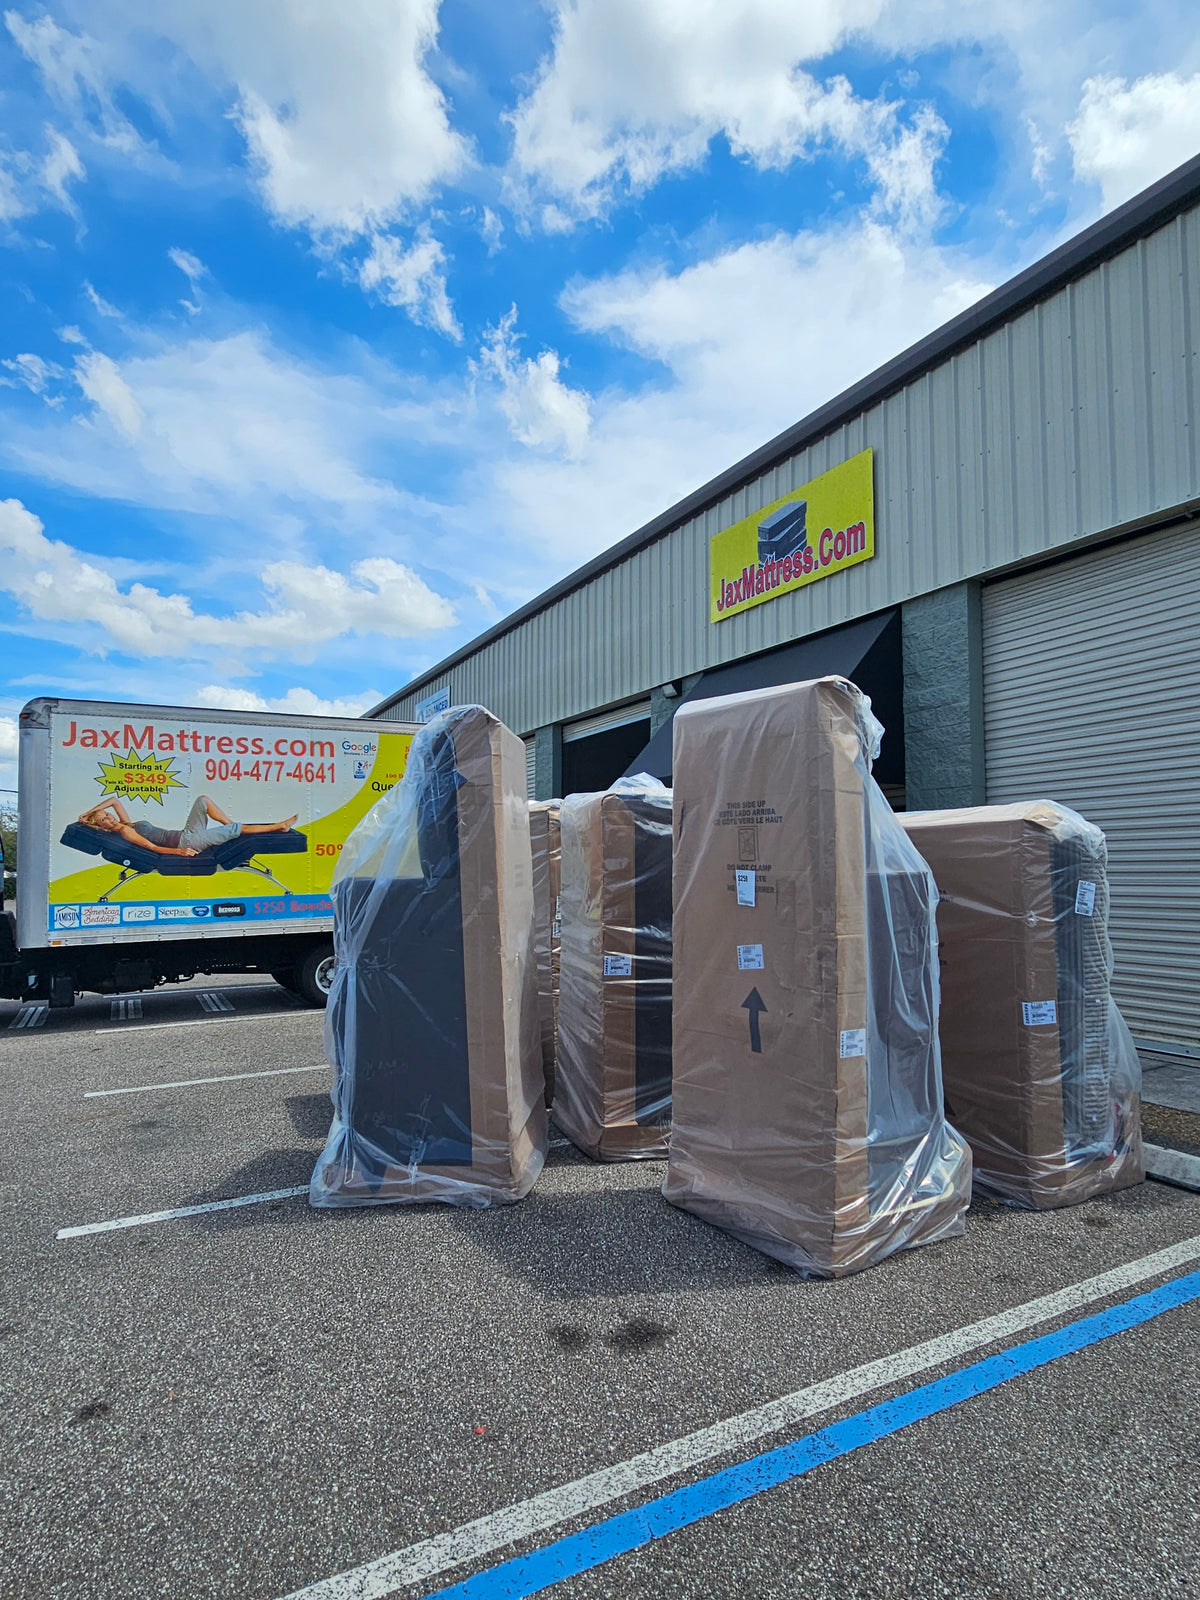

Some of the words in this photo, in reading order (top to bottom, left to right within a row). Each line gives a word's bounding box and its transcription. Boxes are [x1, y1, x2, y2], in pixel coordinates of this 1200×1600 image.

[717, 521, 866, 612] JaxMattress.Com
[62, 721, 335, 757] JaxMattress.com
[342, 741, 377, 753] Google
[119, 762, 152, 771] Starting
[205, 758, 335, 783] 904-477-4641
[124, 772, 167, 784] $349
[114, 785, 163, 793] Adjustable
[371, 781, 394, 792] Que
[735, 809, 751, 817] LADO
[756, 816, 764, 824] LE
[765, 816, 783, 824] HAUT
[81, 906, 120, 916] American
[254, 901, 285, 914] 5250
[290, 899, 334, 912] Bowde
[127, 909, 151, 918] rize
[84, 915, 115, 924] Bedding
